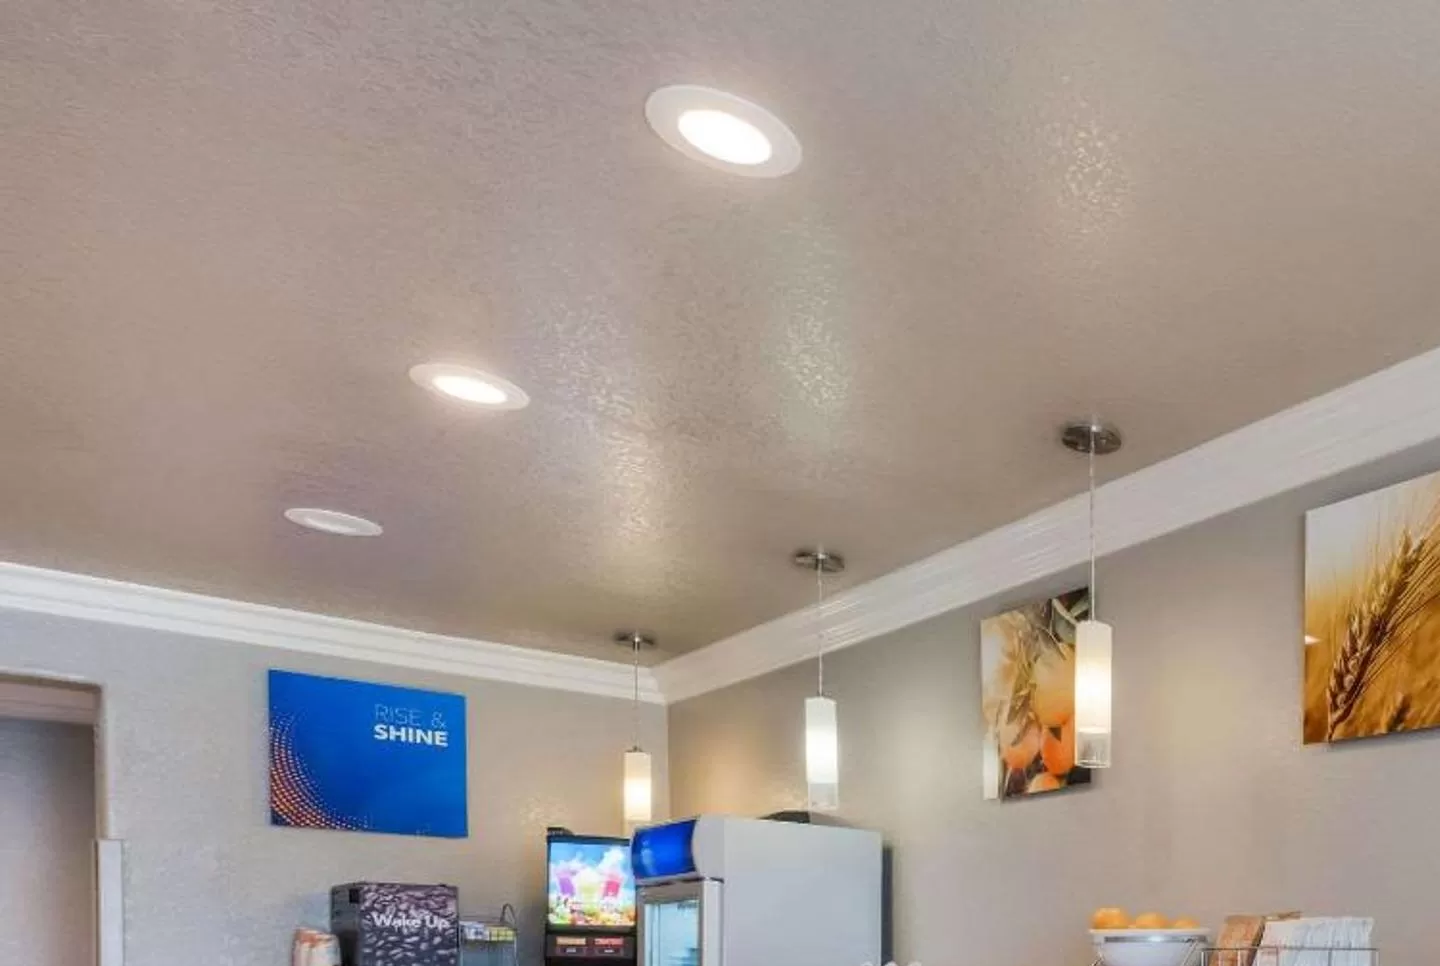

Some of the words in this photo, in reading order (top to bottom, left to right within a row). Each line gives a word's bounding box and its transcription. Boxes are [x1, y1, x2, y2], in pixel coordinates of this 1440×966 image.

[375, 703, 421, 726] RISE
[432, 709, 446, 729] &
[373, 723, 449, 748] SHINE
[371, 911, 421, 929] Wake
[424, 914, 450, 932] Up
